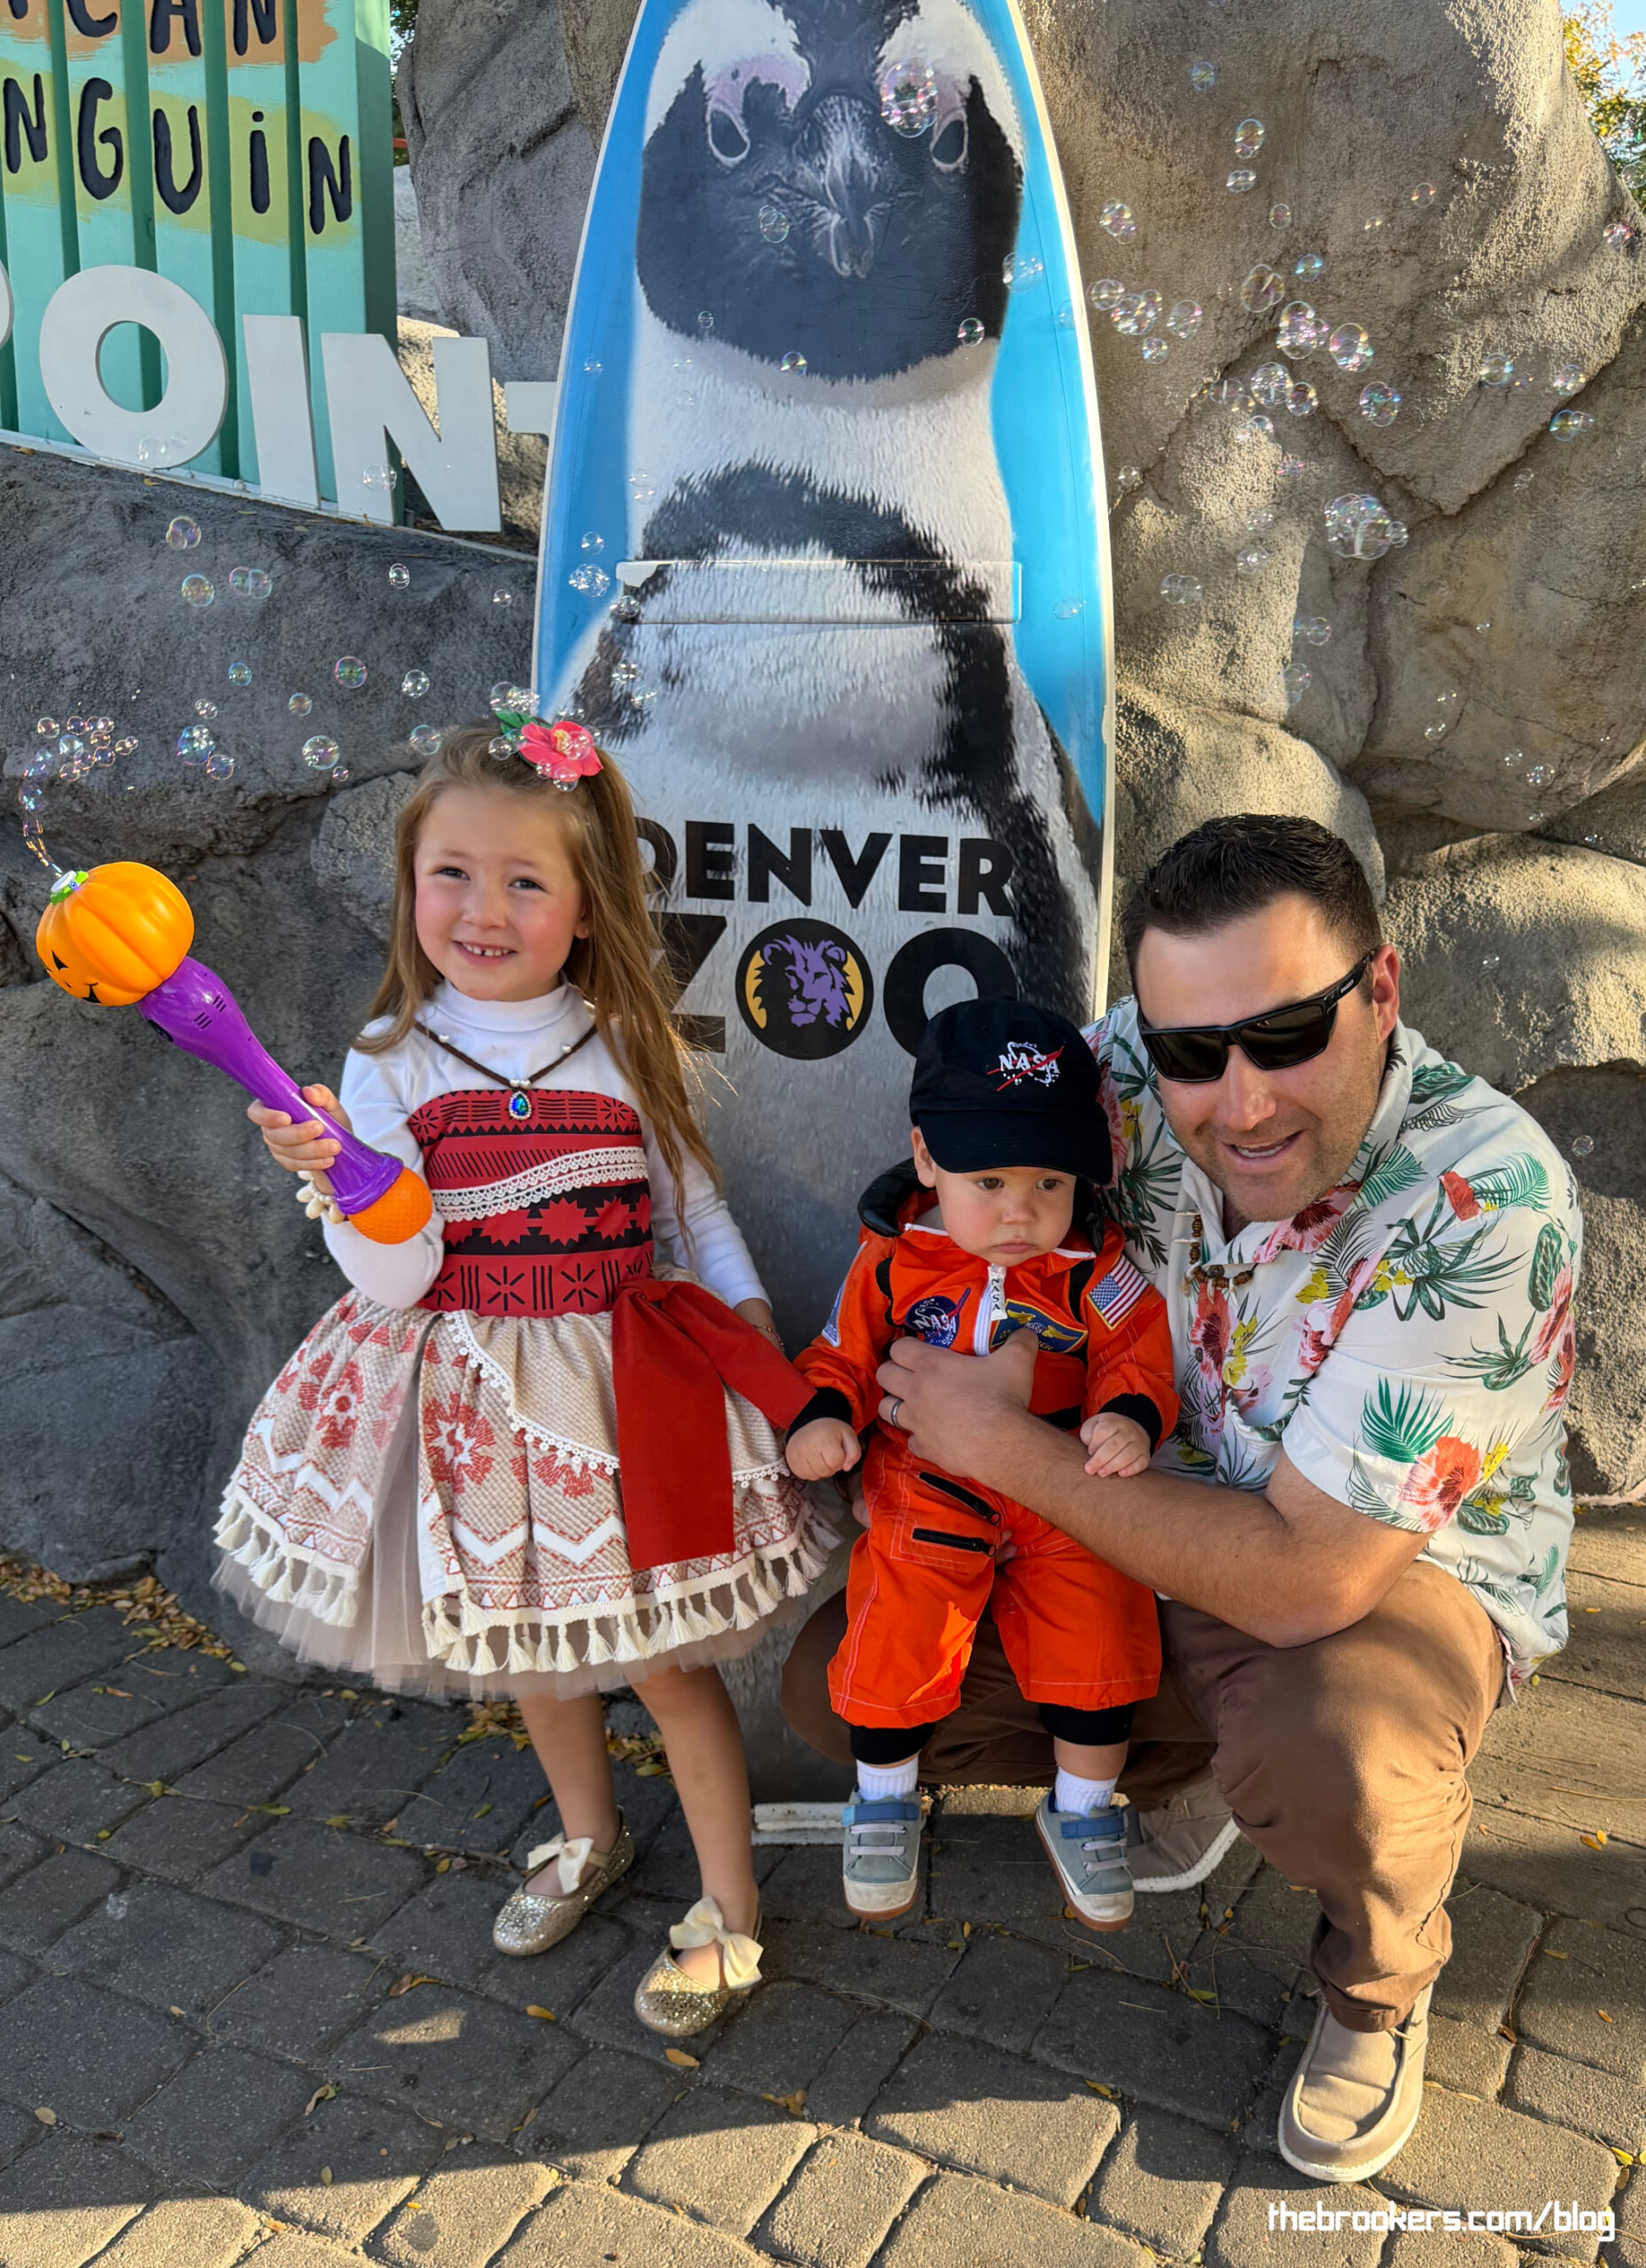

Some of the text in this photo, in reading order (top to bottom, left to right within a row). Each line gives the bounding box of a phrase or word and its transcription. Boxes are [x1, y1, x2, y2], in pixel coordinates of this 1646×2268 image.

[0, 260, 558, 532] OIN
[633, 816, 1015, 917] DENVER
[998, 1052, 1060, 1074] NASA
[991, 1278, 1001, 1311] NASA
[912, 1315, 957, 1333] NASA
